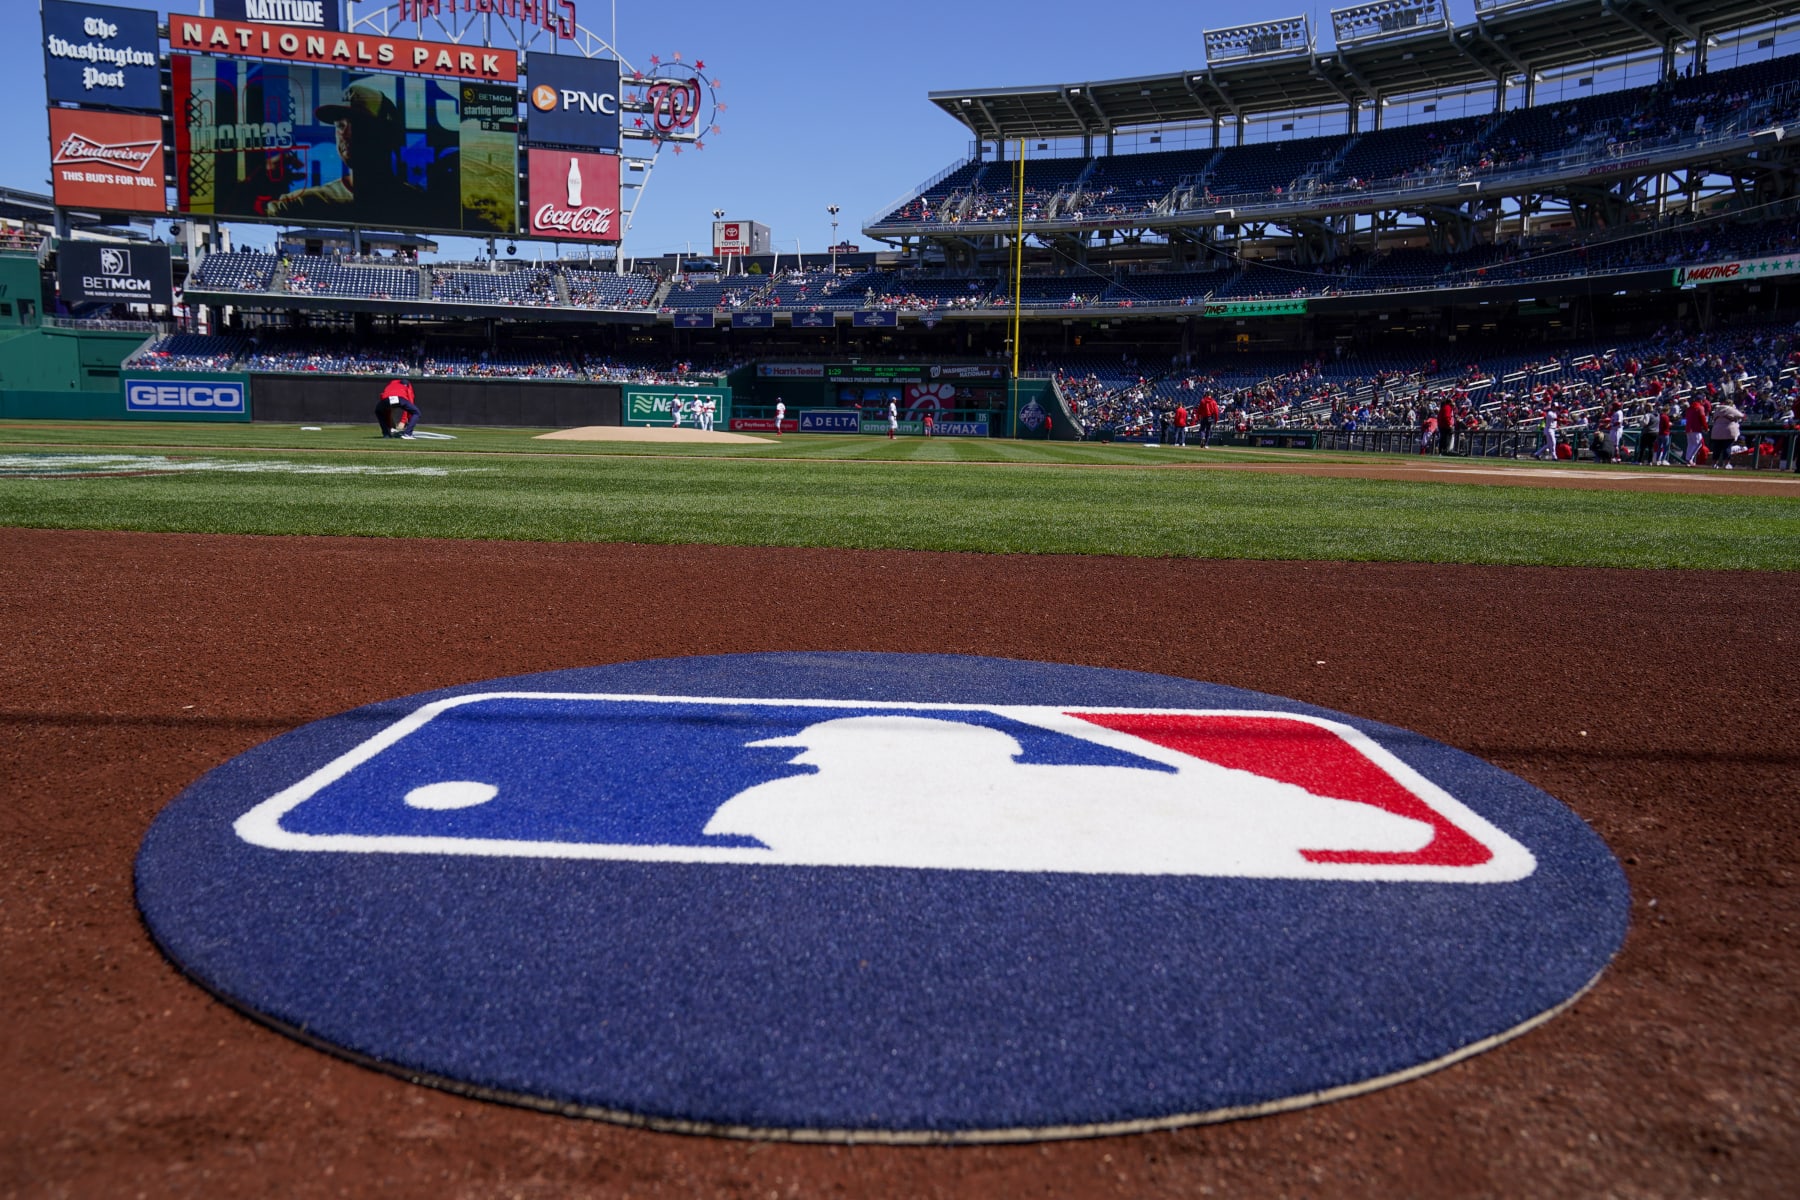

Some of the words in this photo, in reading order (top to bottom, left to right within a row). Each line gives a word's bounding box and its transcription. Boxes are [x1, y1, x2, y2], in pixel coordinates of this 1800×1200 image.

[245, 0, 324, 22] NATITUDE
[84, 17, 118, 39] The
[48, 34, 156, 67] Washington
[183, 22, 395, 62] NATIONALS
[414, 47, 498, 73] PARK
[83, 67, 125, 90] Post
[479, 93, 512, 102] BETMGM
[560, 89, 616, 115] PNC
[464, 105, 491, 116] starting
[492, 105, 513, 116] lineup
[189, 121, 293, 152] thomas
[61, 140, 151, 161] Budweiser
[62, 171, 84, 182] THIS
[85, 172, 113, 184] BUD'S
[115, 175, 134, 185] FOR
[135, 177, 157, 187] YOU.
[534, 203, 615, 233] Coca-Cola
[83, 276, 151, 290] BETMGM
[1687, 264, 1741, 281] MARTINEZ
[130, 386, 240, 407] GEICO
[815, 418, 858, 427] DELTA
[932, 424, 978, 434] RE/MAX
